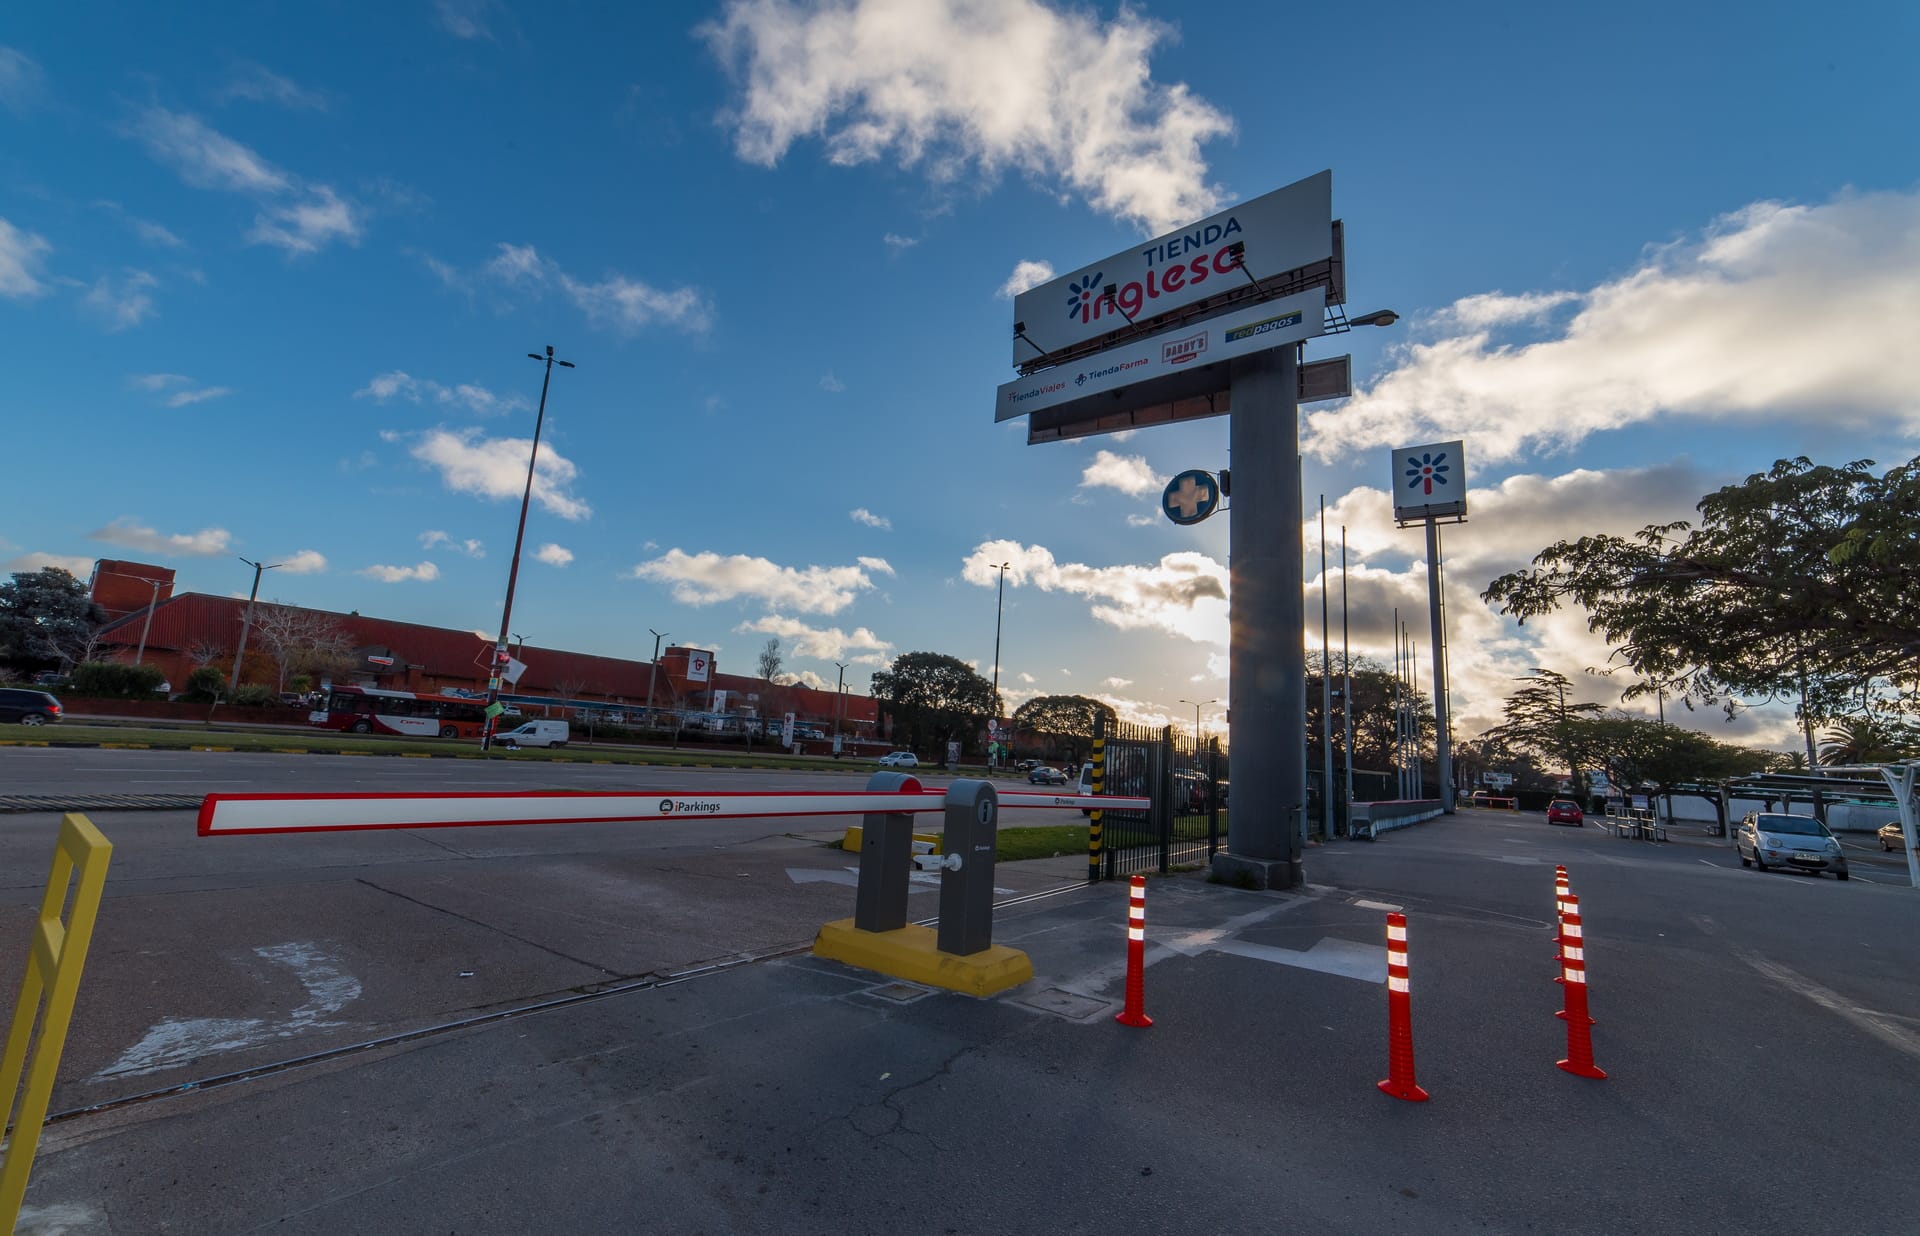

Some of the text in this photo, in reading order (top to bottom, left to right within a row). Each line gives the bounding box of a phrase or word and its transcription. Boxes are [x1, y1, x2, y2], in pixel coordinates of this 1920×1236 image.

[1143, 217, 1242, 267] TIENDA
[1233, 317, 1293, 340] redpagos
[1089, 358, 1149, 380] TiendaFarma
[1012, 382, 1066, 403] TiendaViajes
[674, 801, 721, 813] iParkings
